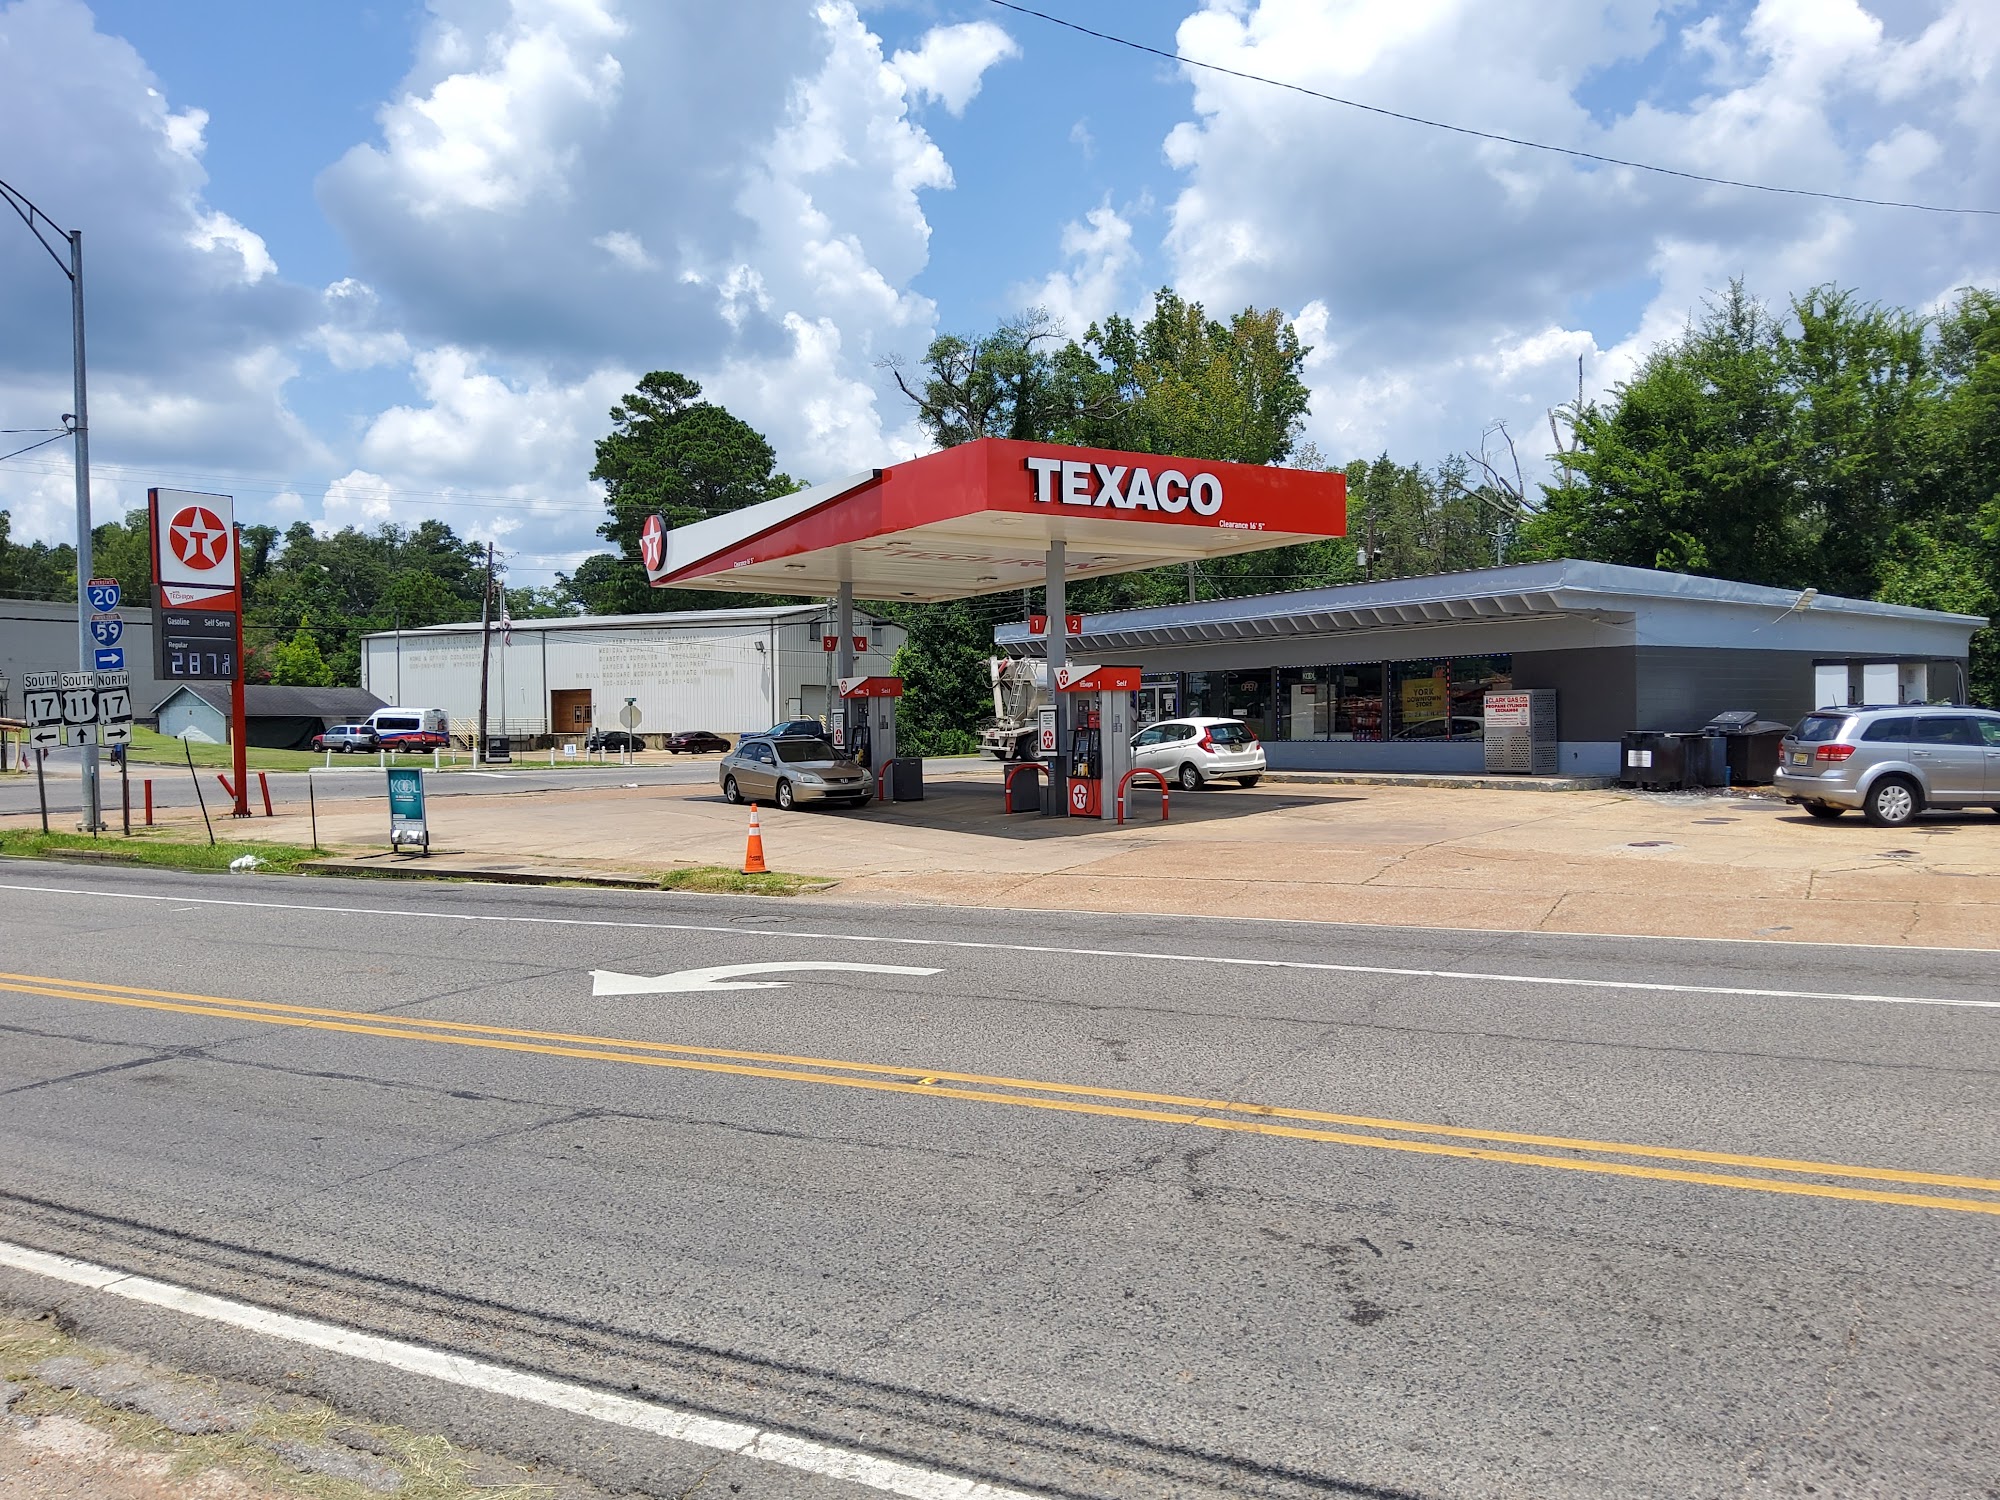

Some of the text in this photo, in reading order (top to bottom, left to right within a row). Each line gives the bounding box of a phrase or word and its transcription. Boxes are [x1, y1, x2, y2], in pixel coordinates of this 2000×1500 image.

[1027, 456, 1223, 516] TEXACO
[1219, 519, 1248, 529] Clearance
[93, 588, 117, 606] 20
[167, 617, 231, 628] Gasoline Self Serve
[1034, 619, 1039, 630] 1
[1072, 619, 1078, 630] 2
[96, 623, 119, 641] 59
[168, 641, 189, 650] Regular
[826, 639, 832, 648] 3
[858, 639, 864, 648] 4
[25, 675, 57, 687] SOUTH
[62, 675, 94, 687] SOUTH
[97, 674, 128, 686] NORTH
[1116, 679, 1127, 687] Self
[1413, 688, 1434, 696] YORK
[1407, 695, 1442, 703] DOWNTOWN
[30, 698, 54, 718] 17
[70, 697, 88, 717] 11
[102, 696, 124, 716] 17
[390, 779, 421, 794] KOOL
